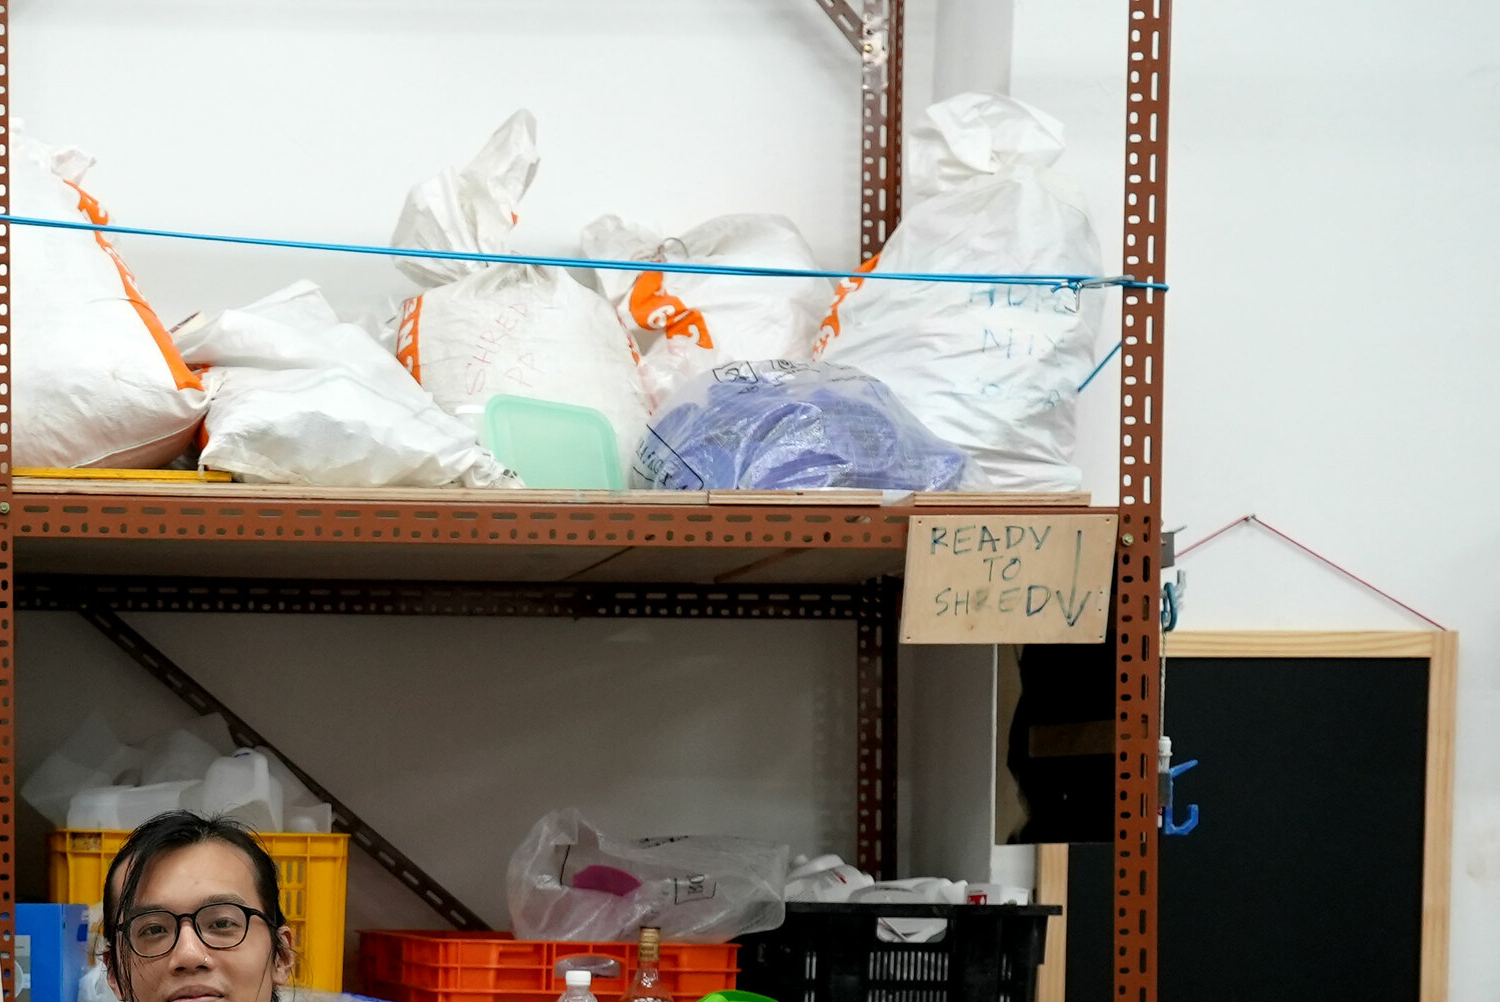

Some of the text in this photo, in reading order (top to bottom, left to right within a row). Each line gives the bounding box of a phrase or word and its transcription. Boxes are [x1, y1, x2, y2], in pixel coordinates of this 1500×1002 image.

[930, 525, 1051, 555] READY
[983, 555, 1021, 582] TO
[935, 584, 1052, 617] SHRED
